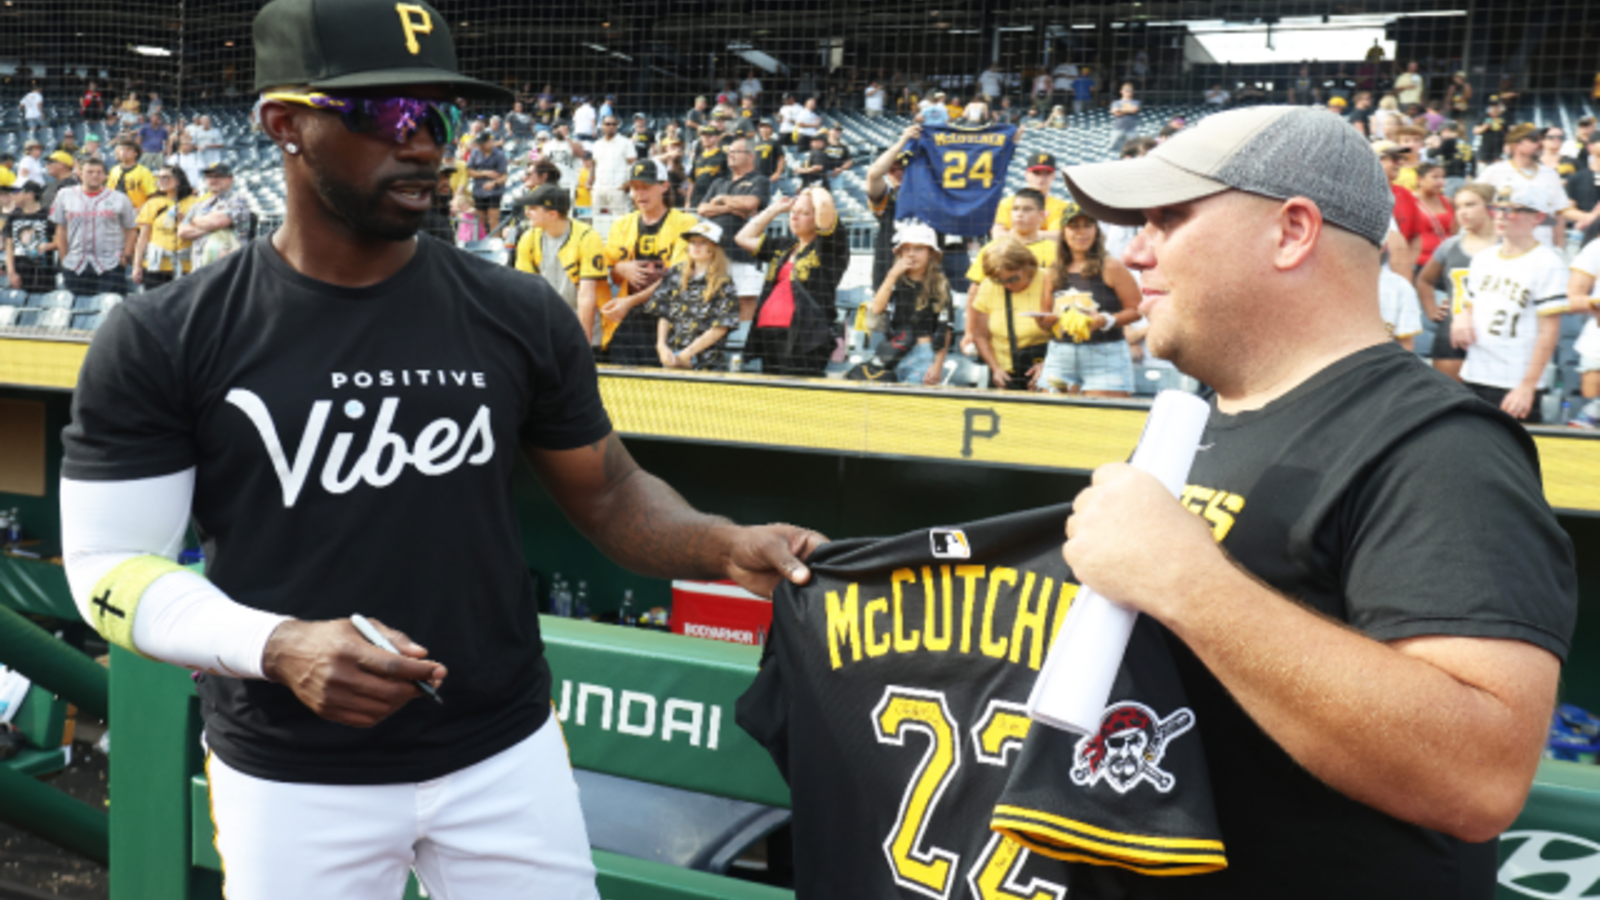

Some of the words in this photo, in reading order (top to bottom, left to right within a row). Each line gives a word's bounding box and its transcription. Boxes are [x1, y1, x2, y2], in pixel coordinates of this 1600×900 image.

[395, 2, 434, 55] P
[942, 149, 994, 189] 24
[1487, 309, 1521, 338] 21
[331, 369, 487, 388] POSITIVE
[225, 387, 495, 508] Vibes
[961, 407, 1001, 457] P
